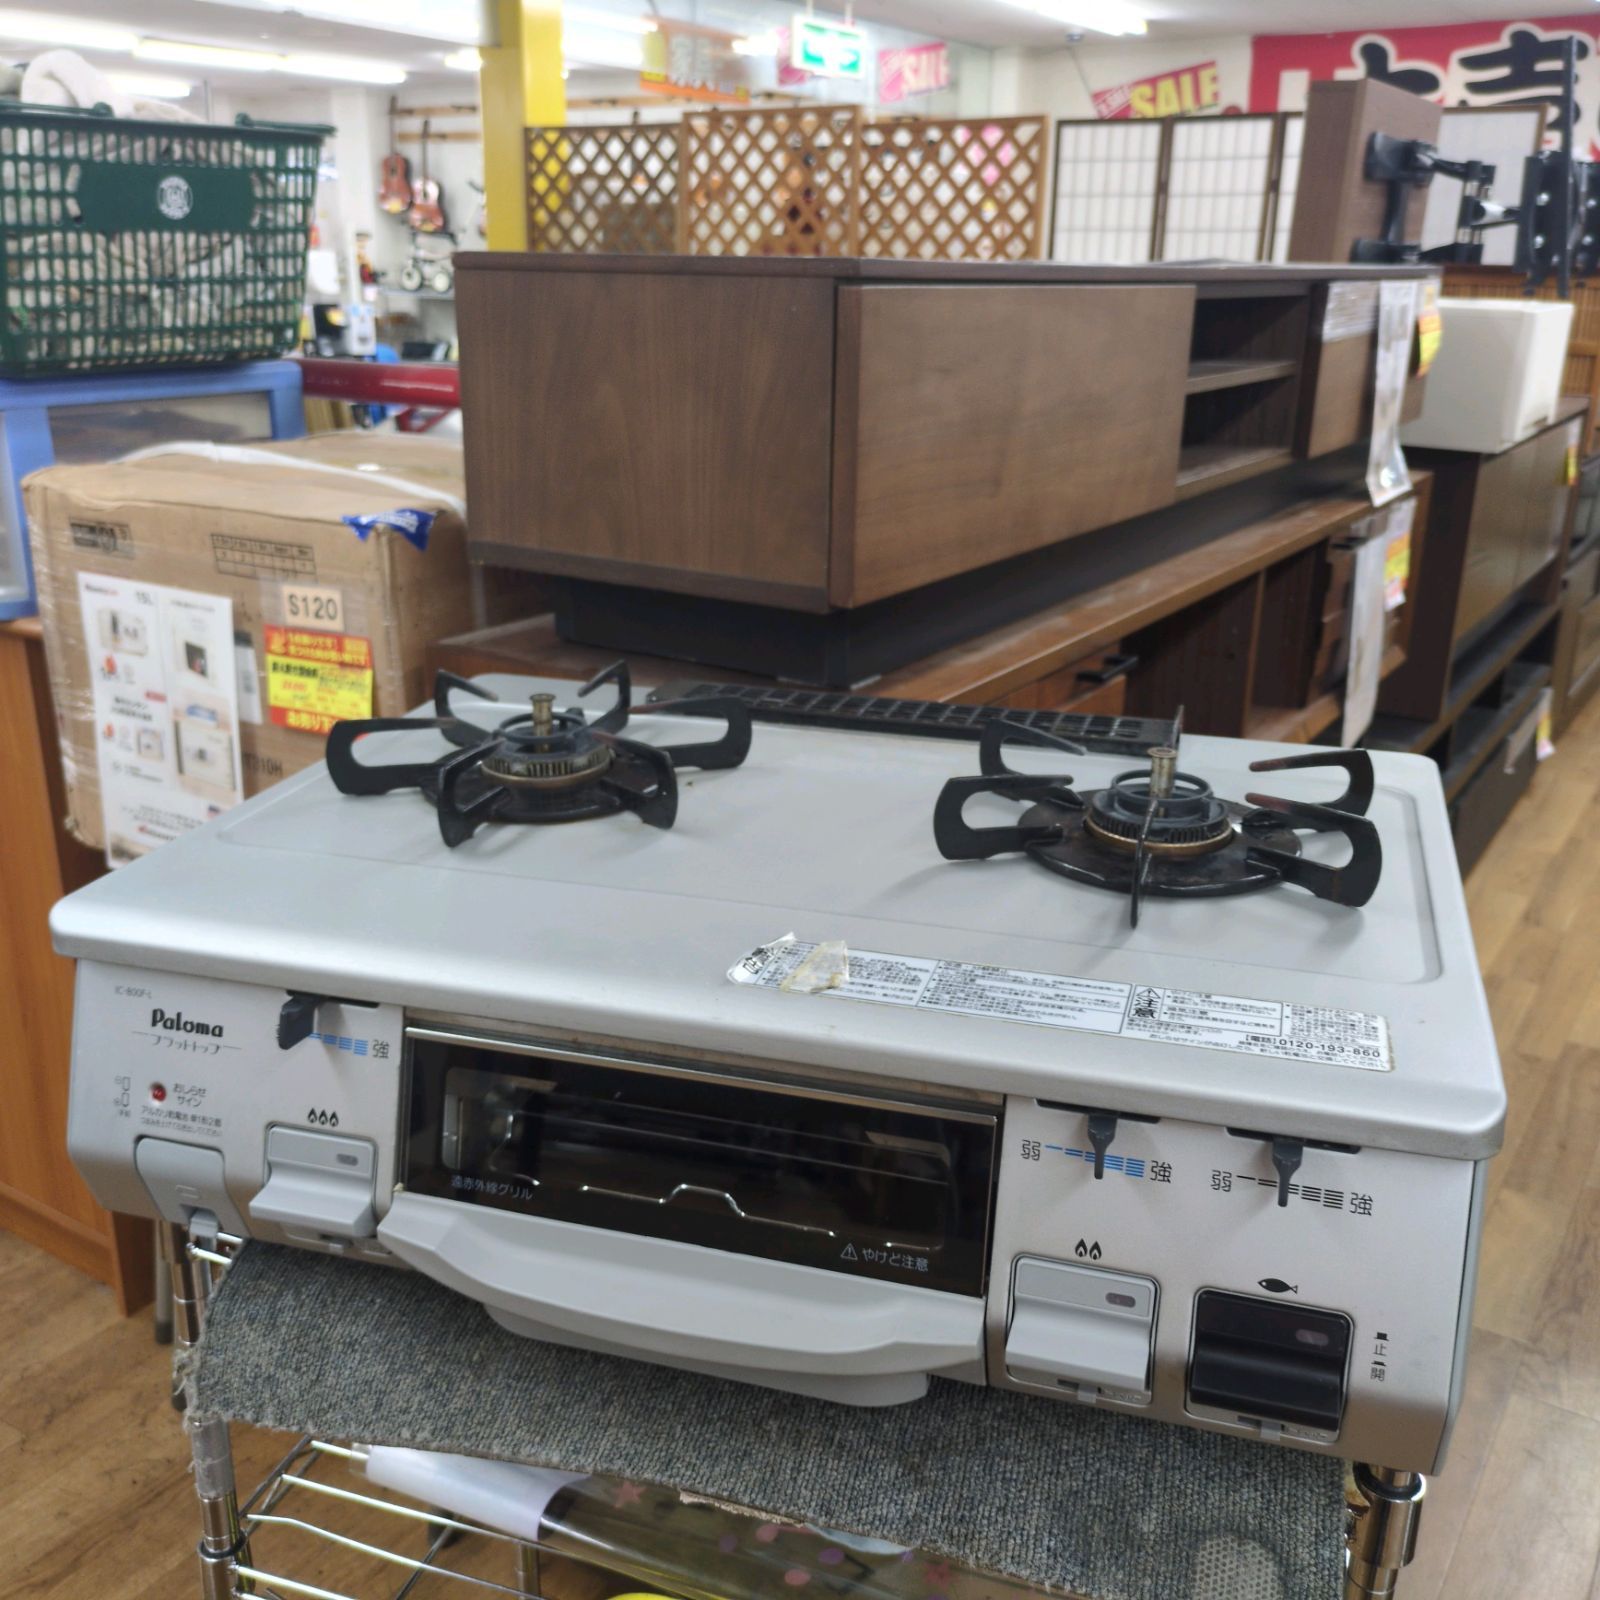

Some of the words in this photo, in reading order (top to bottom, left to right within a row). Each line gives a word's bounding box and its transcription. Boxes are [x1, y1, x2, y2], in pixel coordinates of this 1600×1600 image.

[1130, 67, 1217, 118] SALE
[287, 592, 338, 621] S120
[150, 1007, 224, 1038] Paloma
[150, 1033, 221, 1055] フラットトップ
[372, 1039, 390, 1060] 強
[173, 1083, 207, 1097] おしらせ
[177, 1096, 203, 1108] サイン
[1021, 1139, 1042, 1162] 弱
[1150, 1159, 1173, 1184] 強
[1210, 1169, 1233, 1193] 弱
[1349, 1192, 1374, 1218] 強
[862, 1247, 929, 1272] やけど注意
